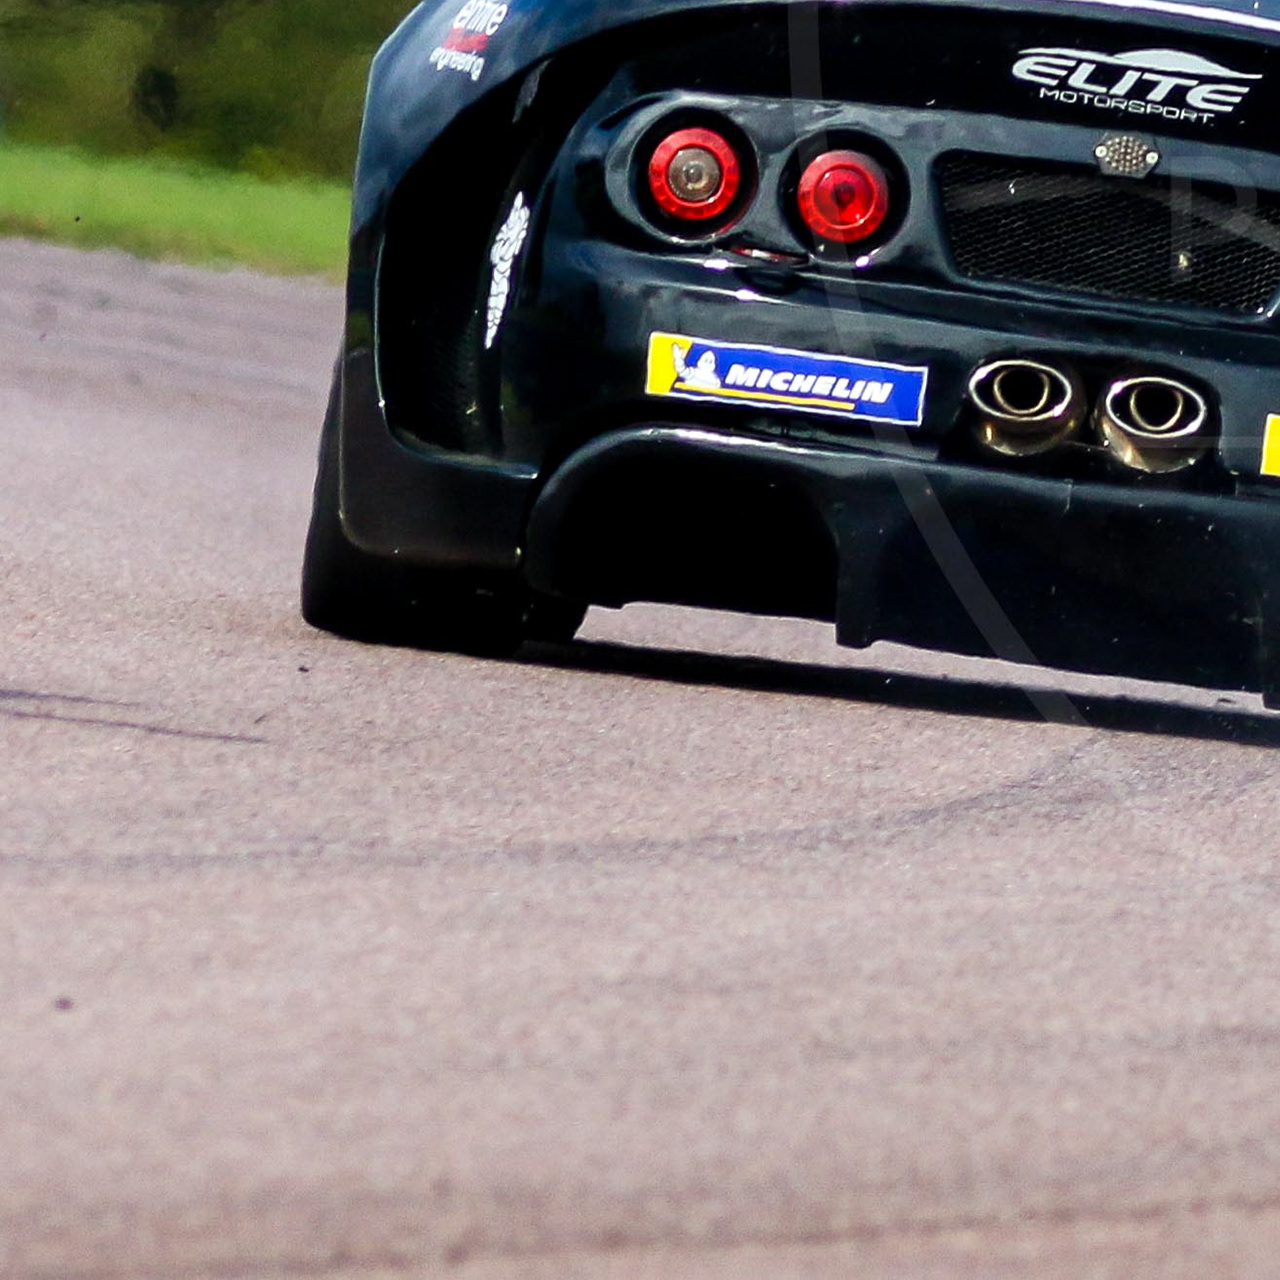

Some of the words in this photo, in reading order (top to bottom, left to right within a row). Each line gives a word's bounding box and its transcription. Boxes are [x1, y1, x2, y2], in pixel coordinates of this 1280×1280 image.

[1012, 56, 1250, 112] ELITE
[1040, 87, 1215, 124] MOTORSPORT
[725, 364, 893, 403] MICHELIN
